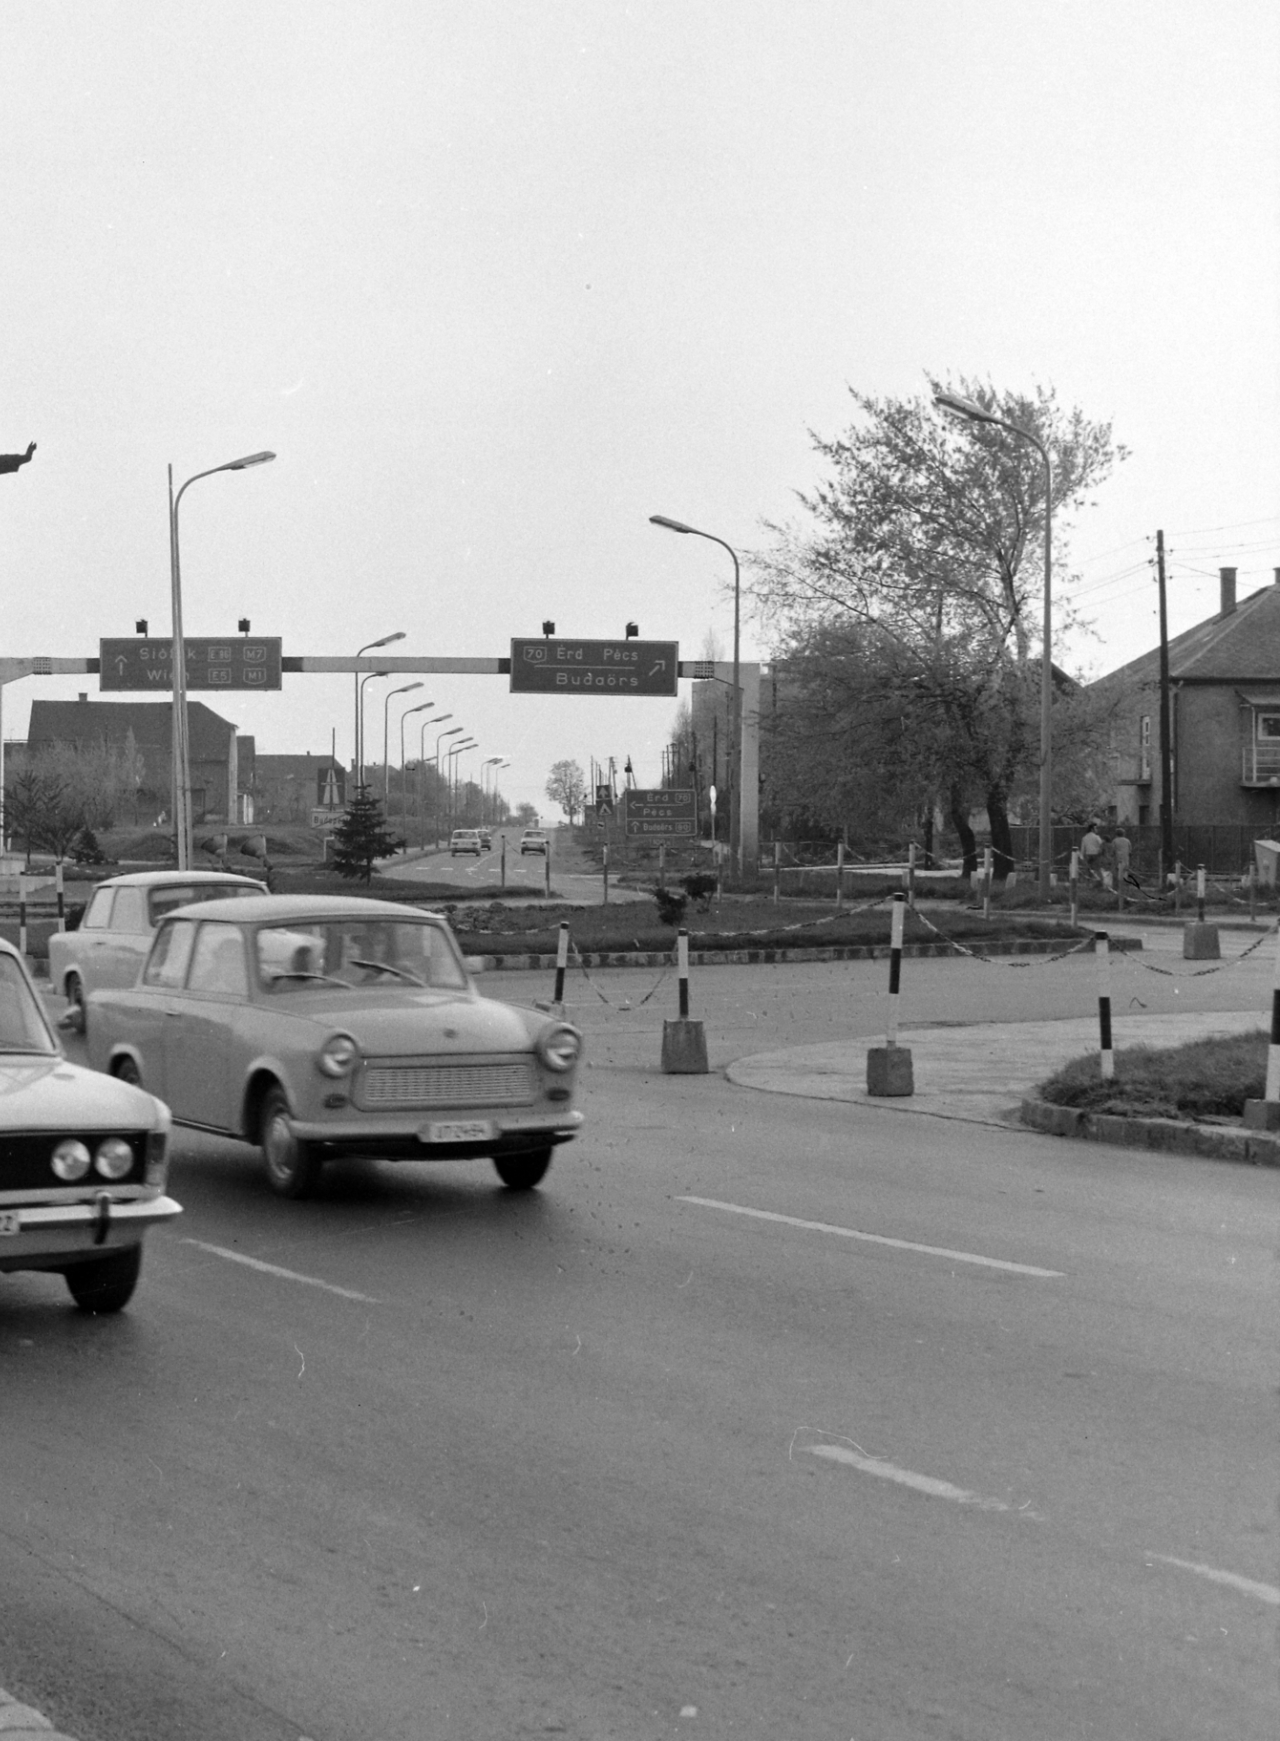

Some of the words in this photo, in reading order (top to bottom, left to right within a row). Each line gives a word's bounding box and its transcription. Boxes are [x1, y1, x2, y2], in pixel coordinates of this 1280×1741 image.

[246, 650, 263, 659] M7
[527, 649, 543, 659] 70
[557, 644, 583, 660] Érd
[603, 648, 638, 661] Pécs
[248, 671, 262, 680] M1
[556, 672, 638, 687] Budaörs
